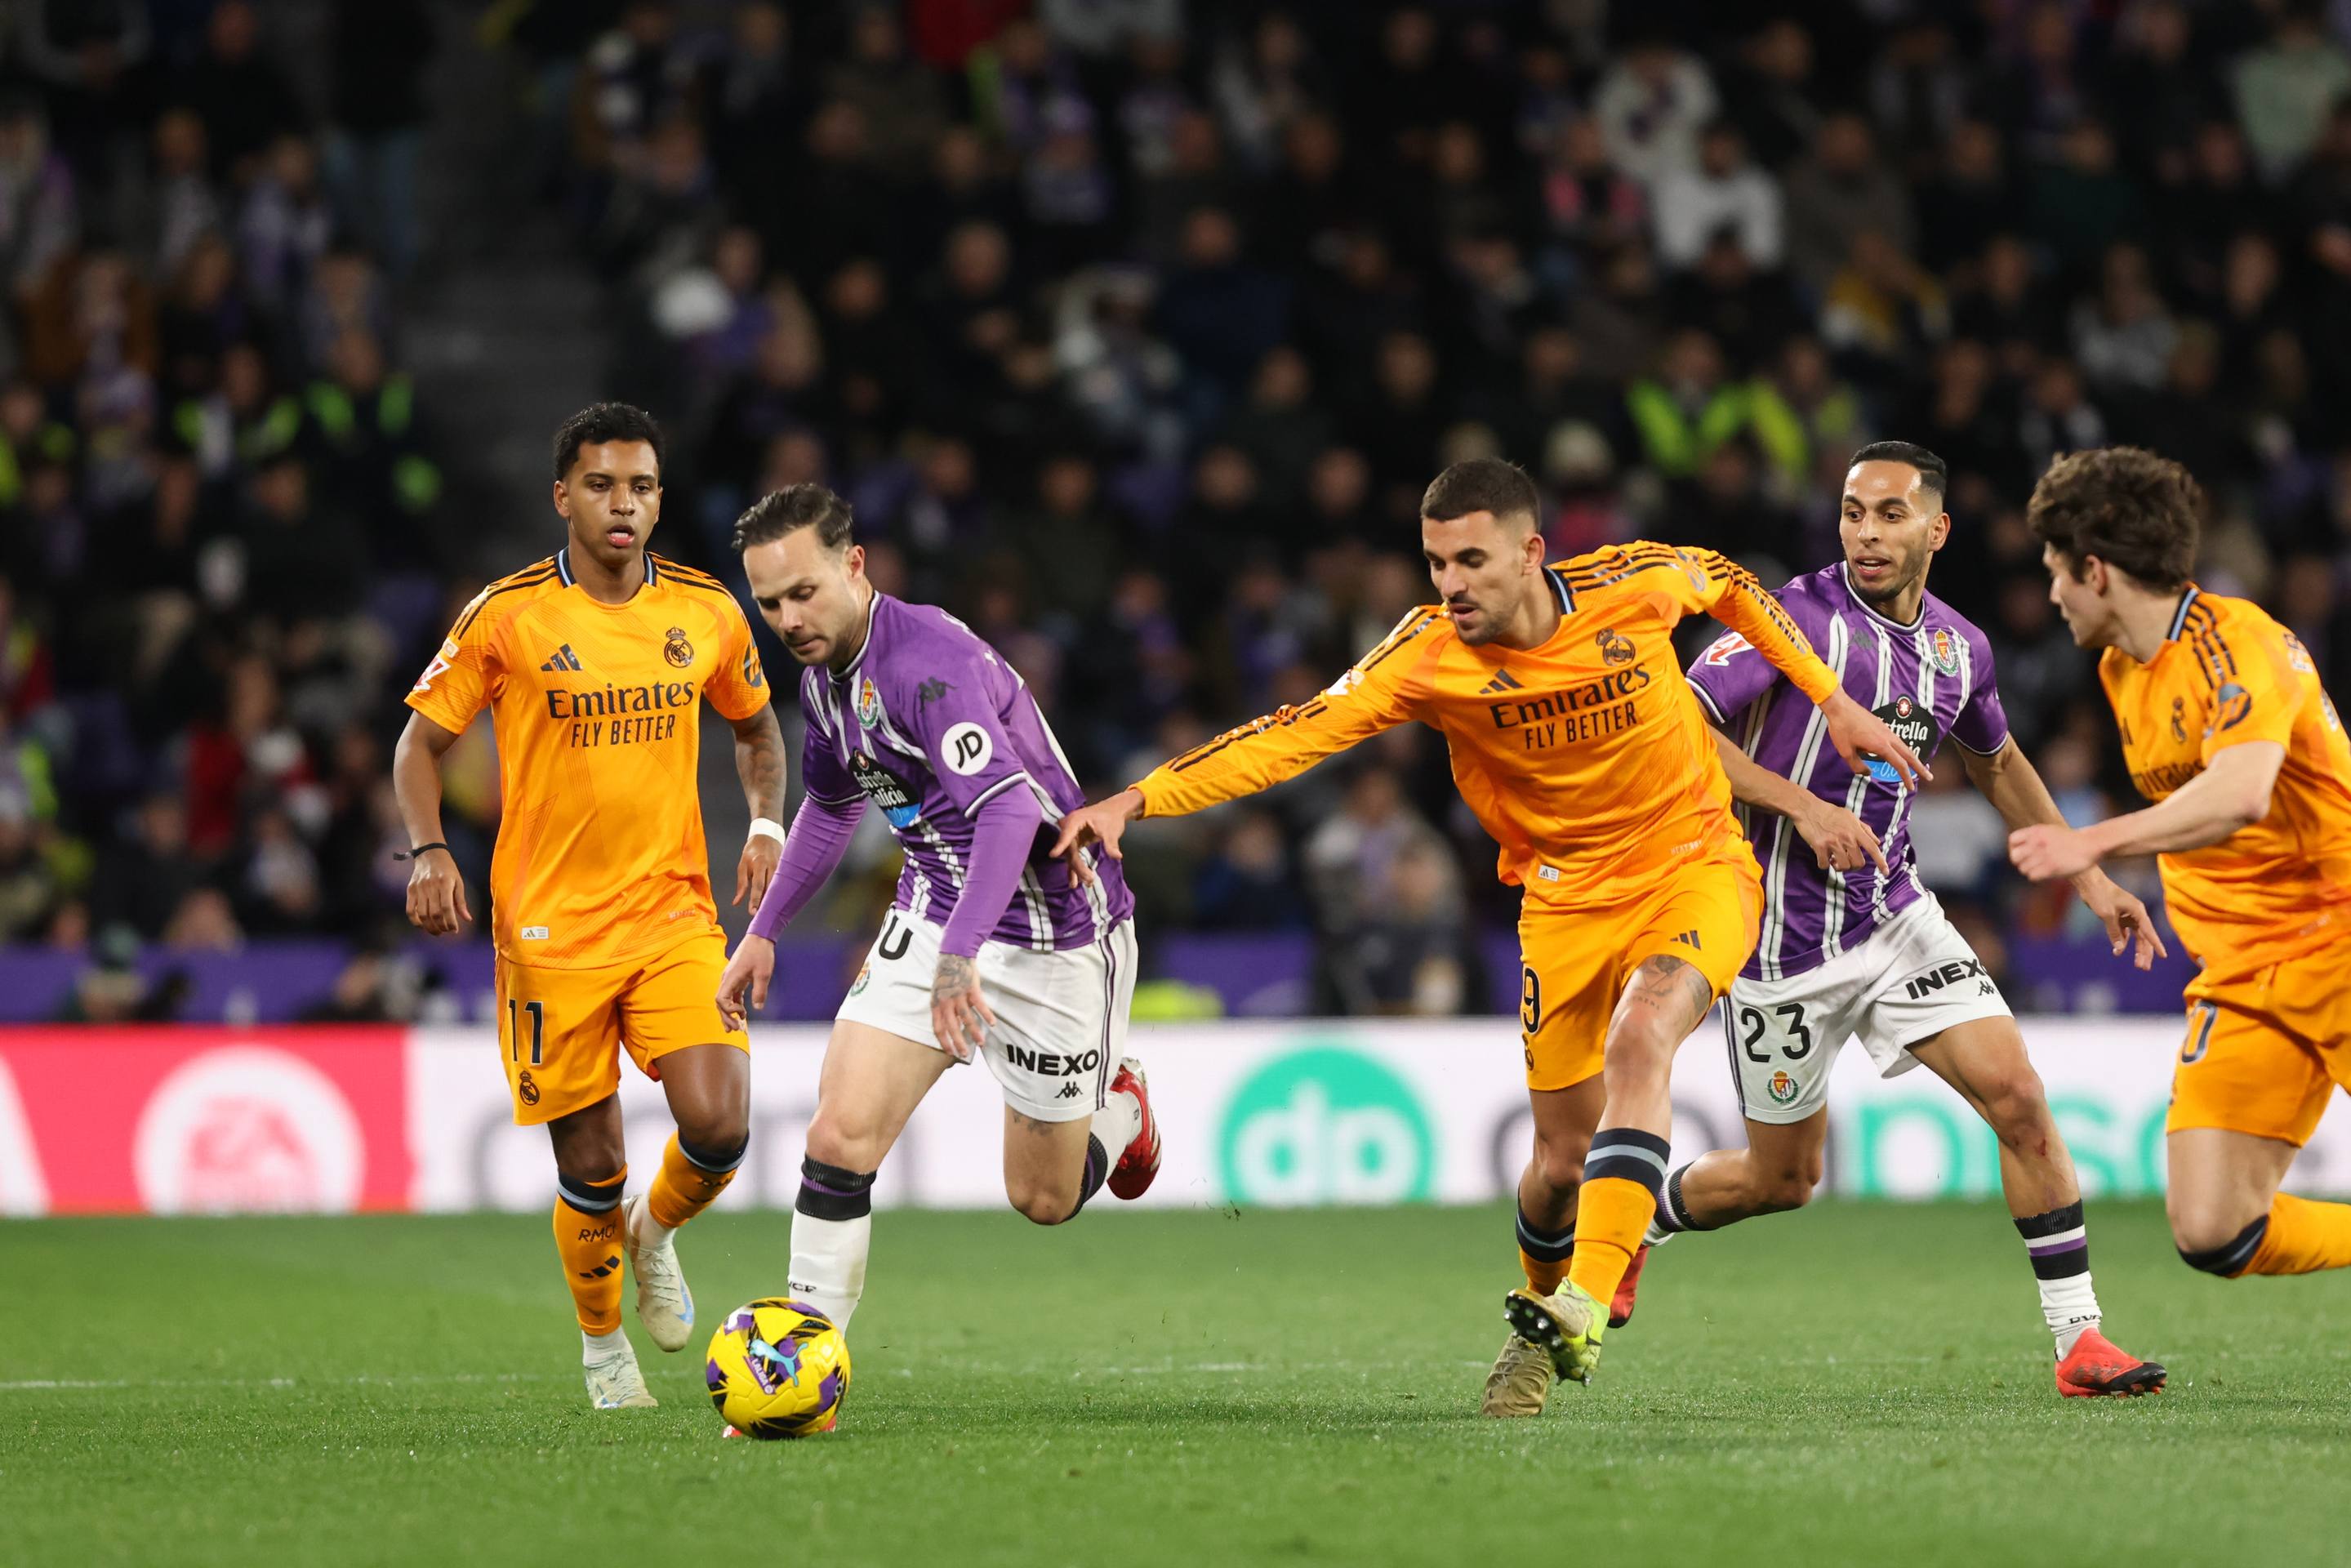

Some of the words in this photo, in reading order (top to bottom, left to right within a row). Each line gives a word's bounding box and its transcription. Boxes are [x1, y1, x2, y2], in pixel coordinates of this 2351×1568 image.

[545, 680, 694, 719] Emirates
[1489, 662, 1650, 728] Emirates
[571, 722, 603, 748] FLY
[610, 714, 675, 746] BETTER
[1525, 722, 1555, 750] FLY
[1565, 701, 1636, 743] BETTER
[955, 730, 983, 769] JD
[1905, 958, 1987, 1000] INEX
[508, 999, 543, 1065] 11
[1740, 1002, 1811, 1062] 23
[1006, 1044, 1099, 1076] INEXO
